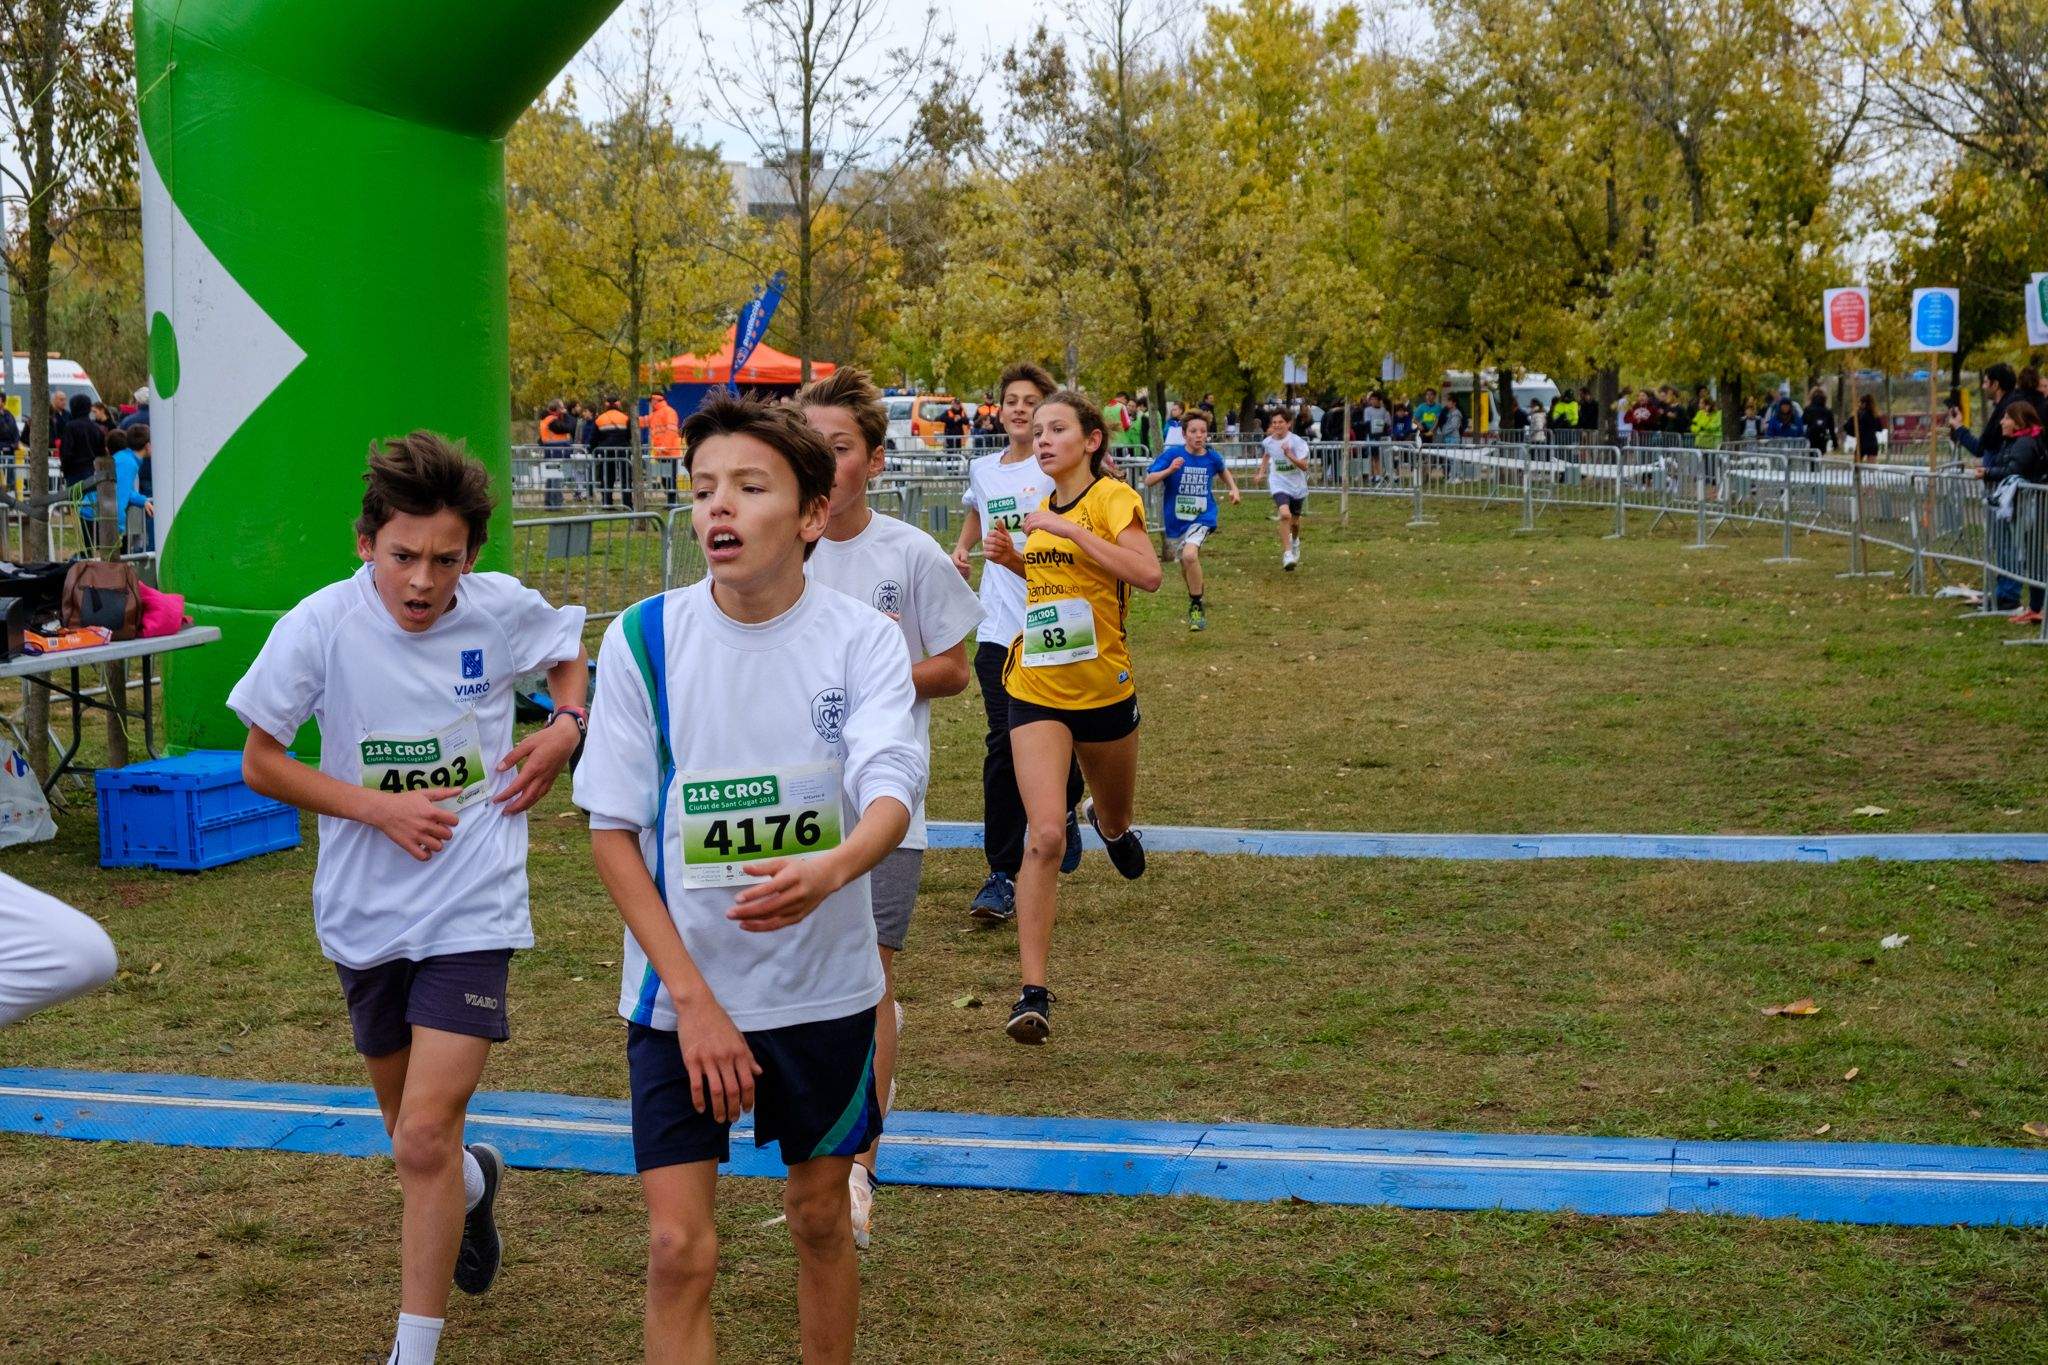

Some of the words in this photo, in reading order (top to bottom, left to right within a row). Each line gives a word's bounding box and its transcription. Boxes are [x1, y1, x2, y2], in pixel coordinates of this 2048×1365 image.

[993, 513, 1030, 530] 12
[1038, 608, 1056, 619] CROS
[1042, 627, 1067, 649] 83
[454, 679, 490, 696] VIARÓ
[365, 743, 392, 756] 21è
[395, 742, 436, 756] CROS
[379, 756, 469, 794] 4693
[687, 785, 720, 803] 21è
[724, 780, 775, 800] CROS
[688, 802, 710, 812] Ciutat
[710, 801, 720, 810] de
[721, 800, 737, 809] Sant
[737, 799, 758, 809] Cugat
[759, 796, 776, 805] 2019
[703, 810, 821, 856] 4176
